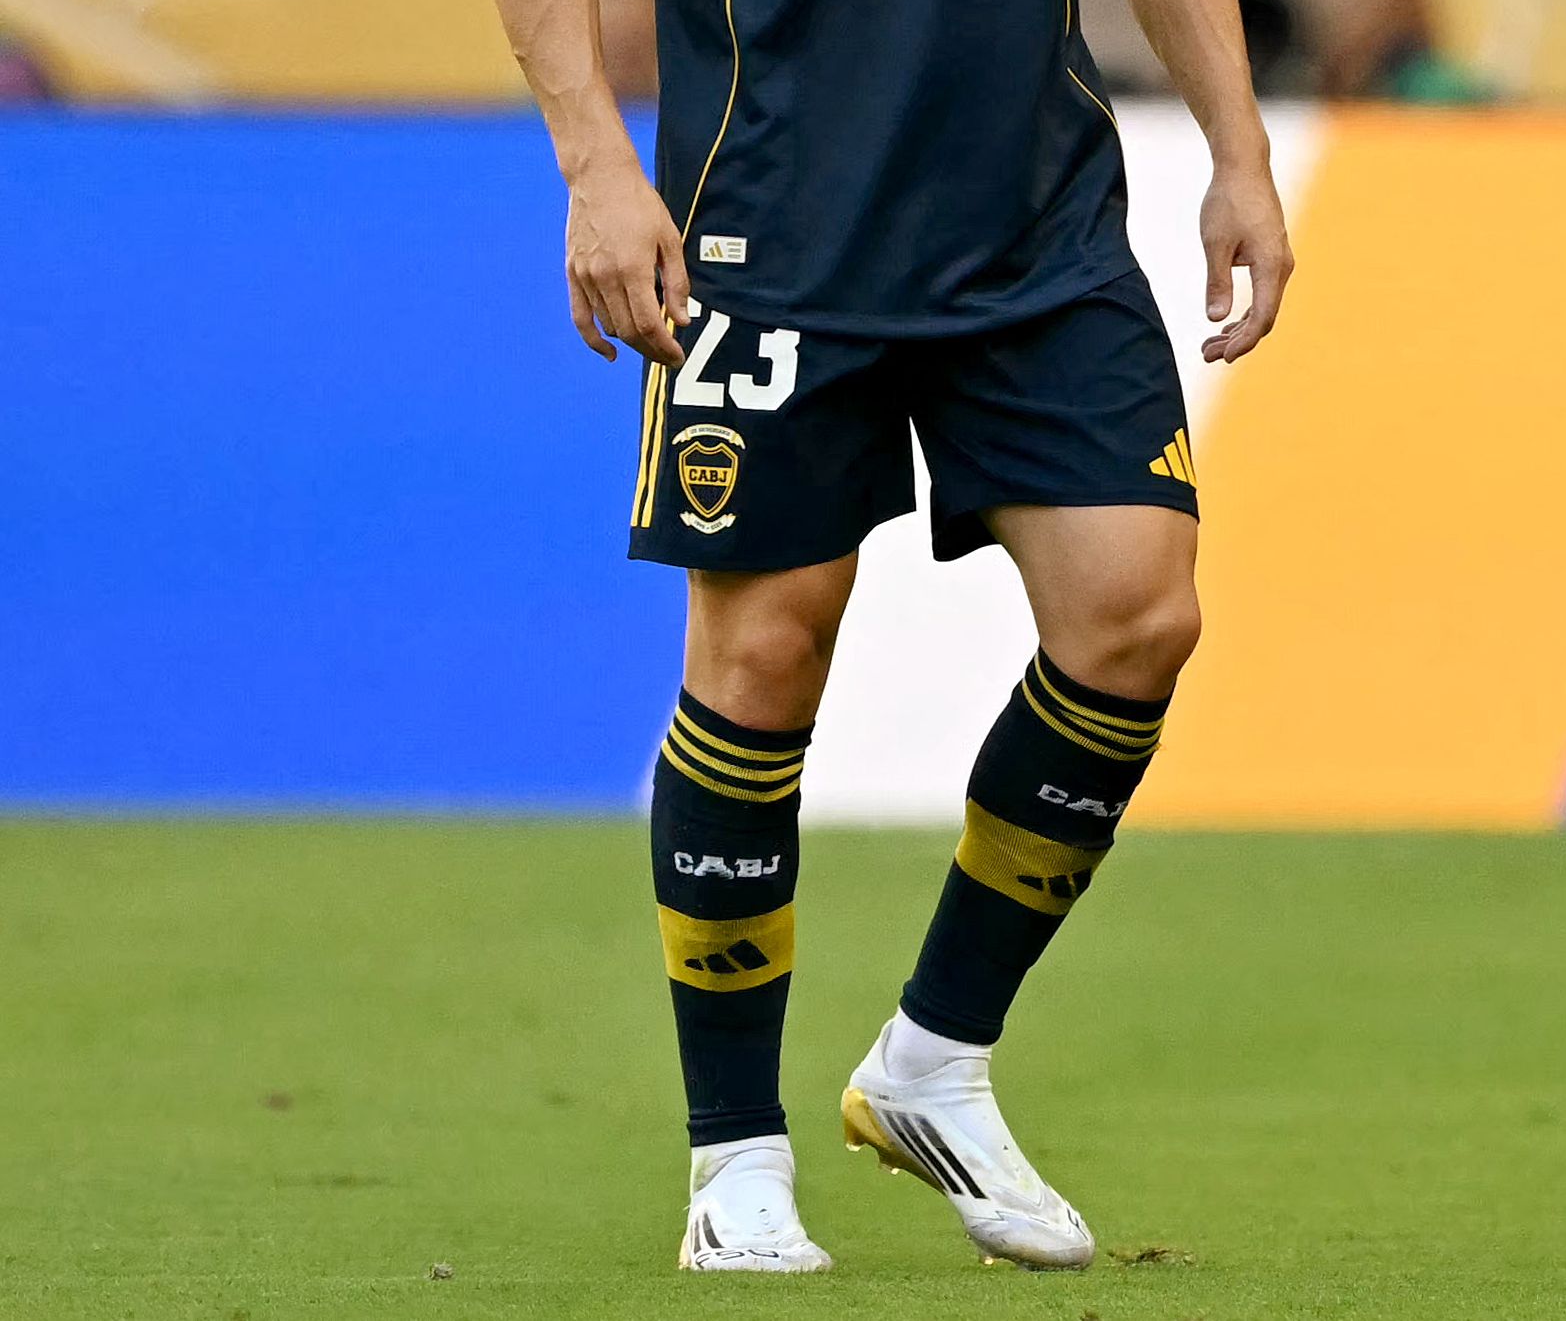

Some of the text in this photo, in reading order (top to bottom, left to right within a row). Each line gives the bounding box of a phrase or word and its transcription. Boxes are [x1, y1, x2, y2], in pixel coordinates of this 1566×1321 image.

[673, 296, 800, 411] 23
[688, 468, 729, 483] CABJ
[674, 851, 781, 879] CABJ
